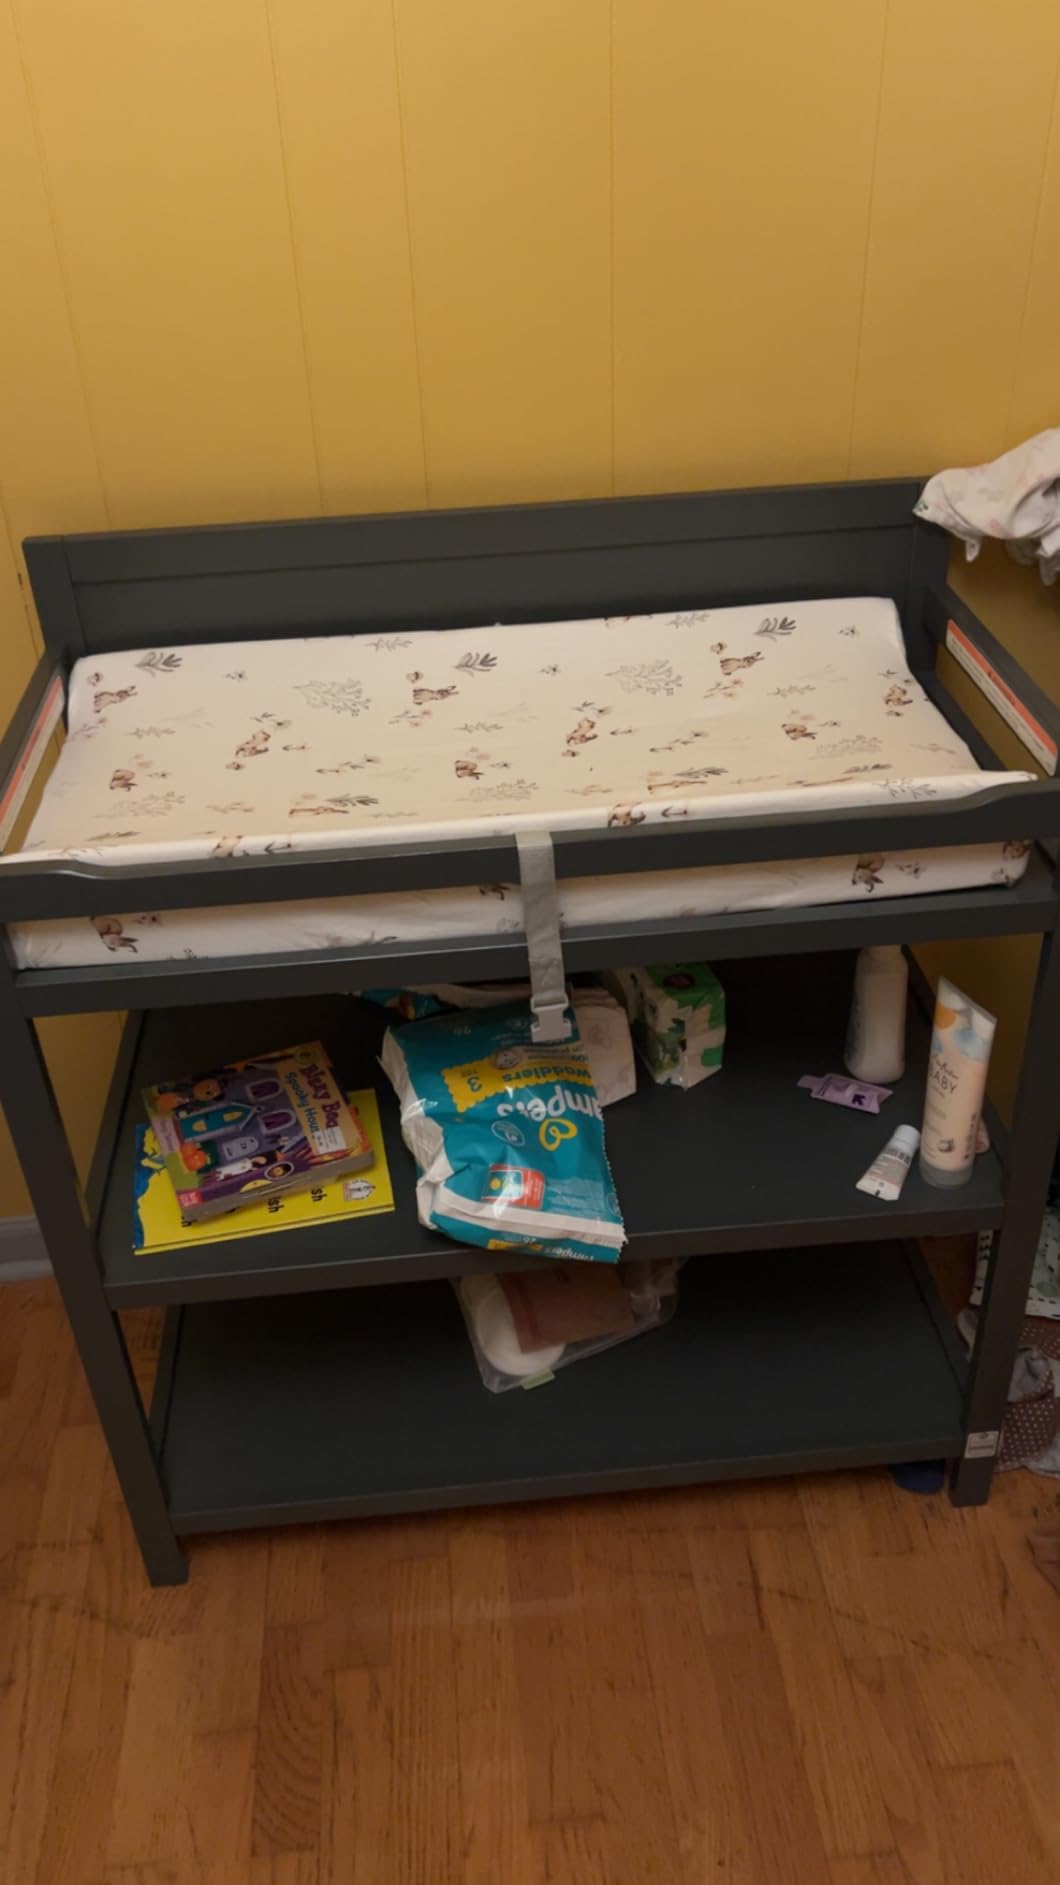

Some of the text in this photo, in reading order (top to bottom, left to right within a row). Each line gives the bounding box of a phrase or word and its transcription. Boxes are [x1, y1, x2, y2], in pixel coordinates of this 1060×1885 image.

[503, 1065, 593, 1083] waddlers
[467, 1076, 482, 1093] 3
[497, 1085, 603, 1122] ampers
